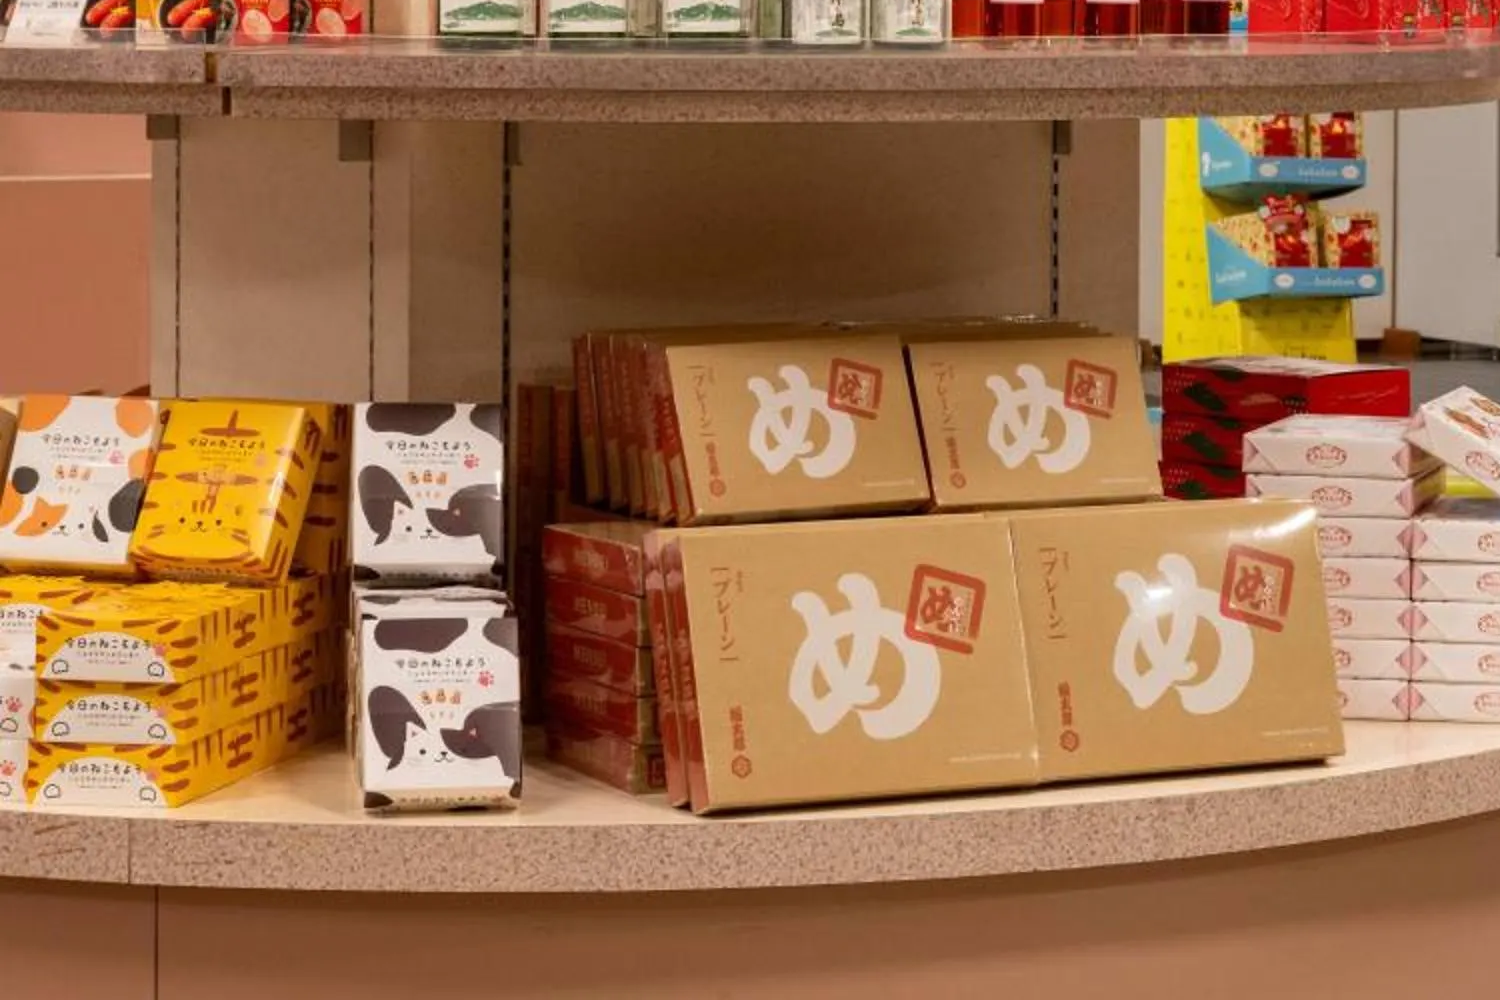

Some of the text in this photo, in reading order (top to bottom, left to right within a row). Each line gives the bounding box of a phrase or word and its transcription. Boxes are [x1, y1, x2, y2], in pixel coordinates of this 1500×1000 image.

[747, 364, 856, 479] め
[985, 364, 1091, 474] め
[789, 572, 940, 740] め
[1114, 553, 1254, 714] め
